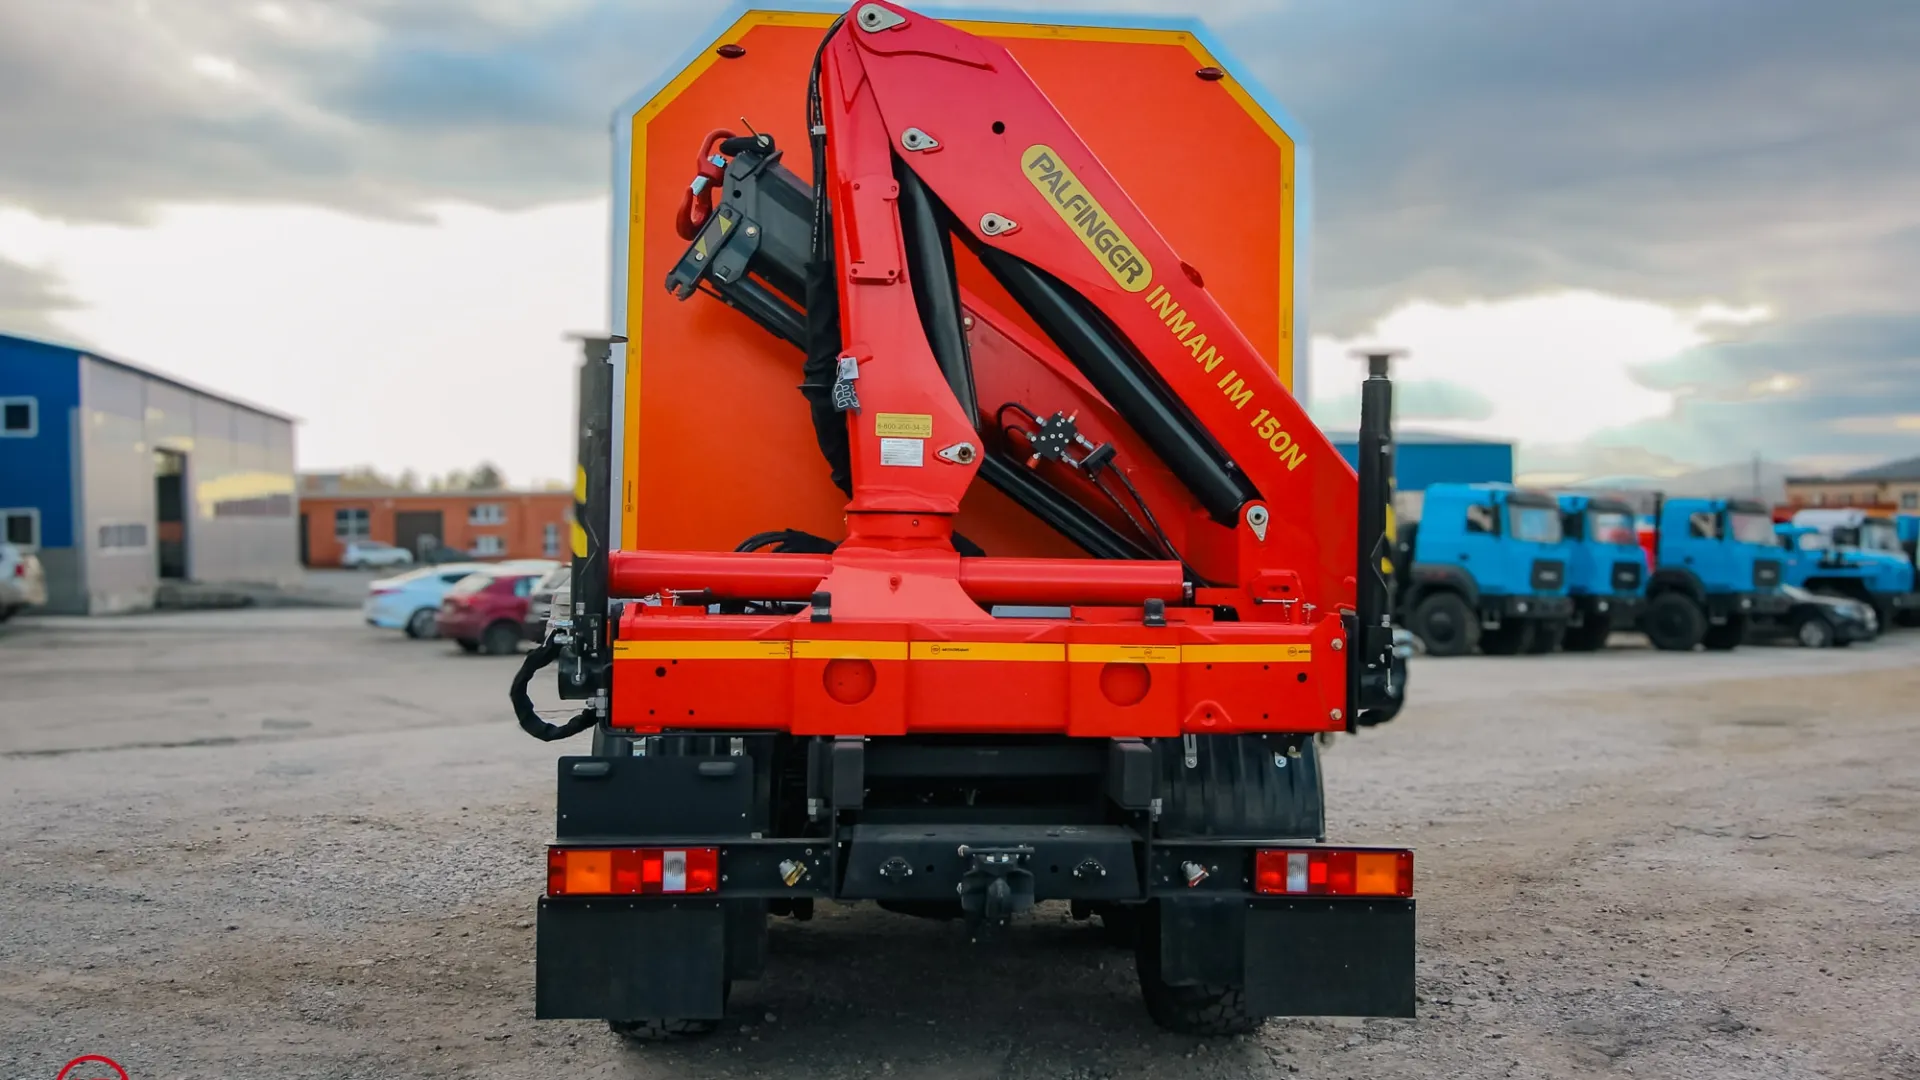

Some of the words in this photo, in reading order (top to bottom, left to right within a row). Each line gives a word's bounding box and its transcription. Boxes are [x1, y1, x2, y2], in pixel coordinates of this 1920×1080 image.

[1029, 152, 1144, 284] PALFINGER
[1145, 285, 1224, 373] INMAN
[1217, 370, 1254, 410] IM
[1250, 408, 1307, 472] 150N
